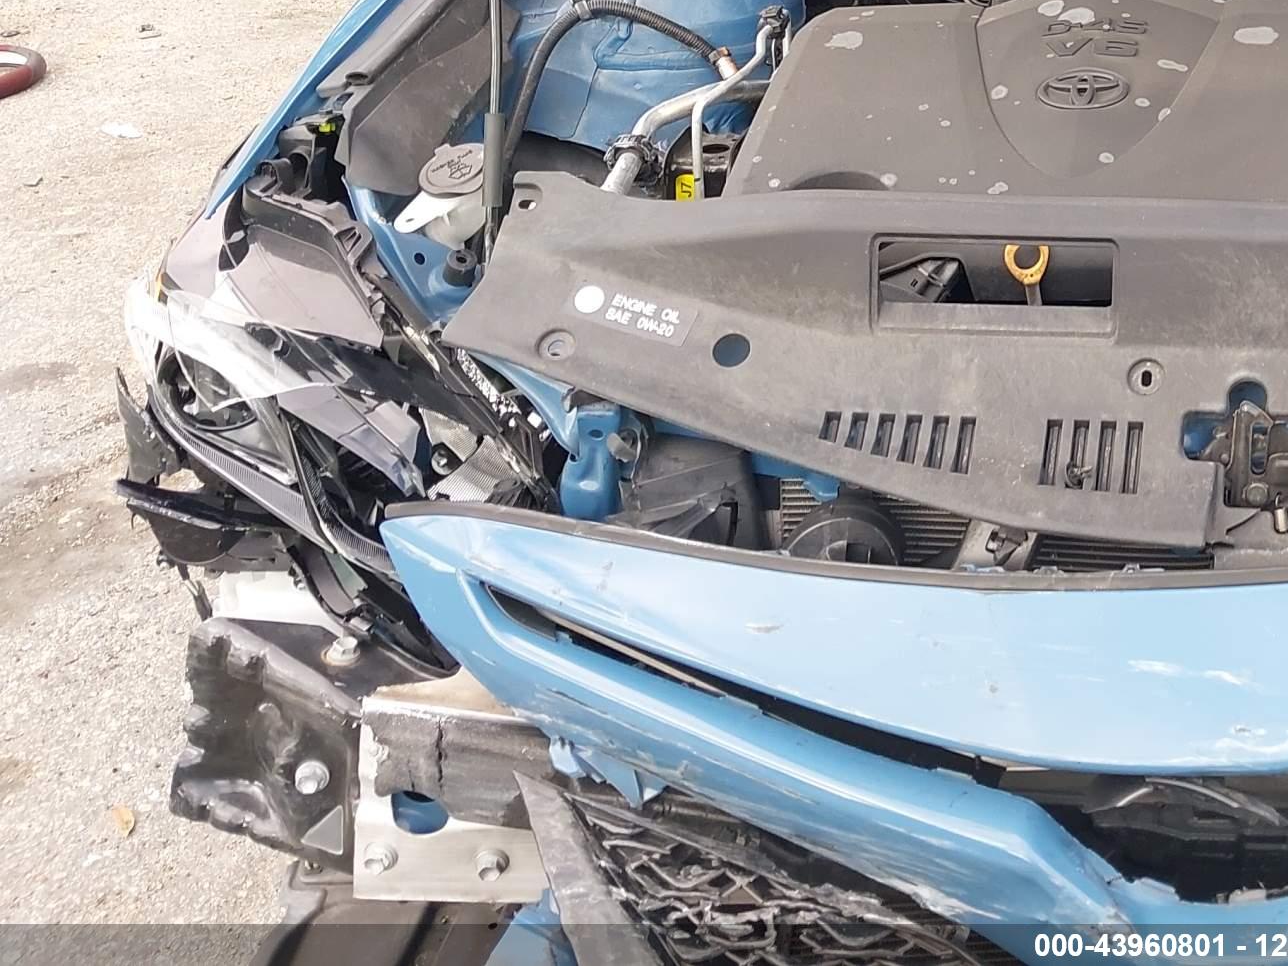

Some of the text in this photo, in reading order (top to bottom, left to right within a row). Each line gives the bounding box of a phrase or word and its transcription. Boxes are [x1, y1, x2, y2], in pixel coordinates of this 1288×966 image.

[1046, 37, 1139, 57] V6
[605, 307, 632, 325] SAE
[611, 294, 680, 324] ENGINE OIL
